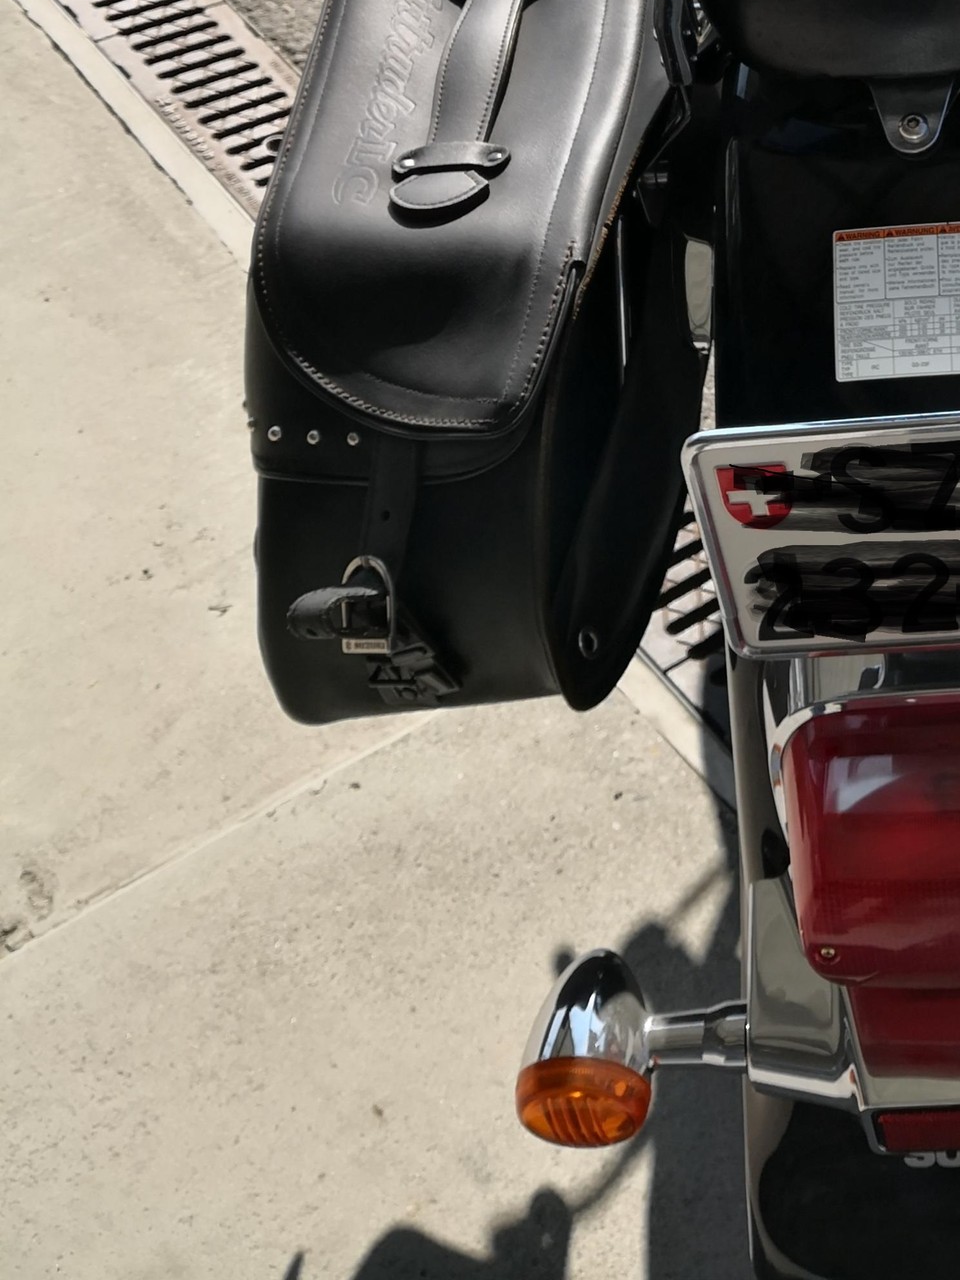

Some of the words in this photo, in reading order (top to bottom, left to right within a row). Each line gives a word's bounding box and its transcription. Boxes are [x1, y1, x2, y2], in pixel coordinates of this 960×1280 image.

[332, 139, 398, 205] LC
[845, 230, 881, 240] WARNING
[895, 226, 936, 236] WARNUNG
